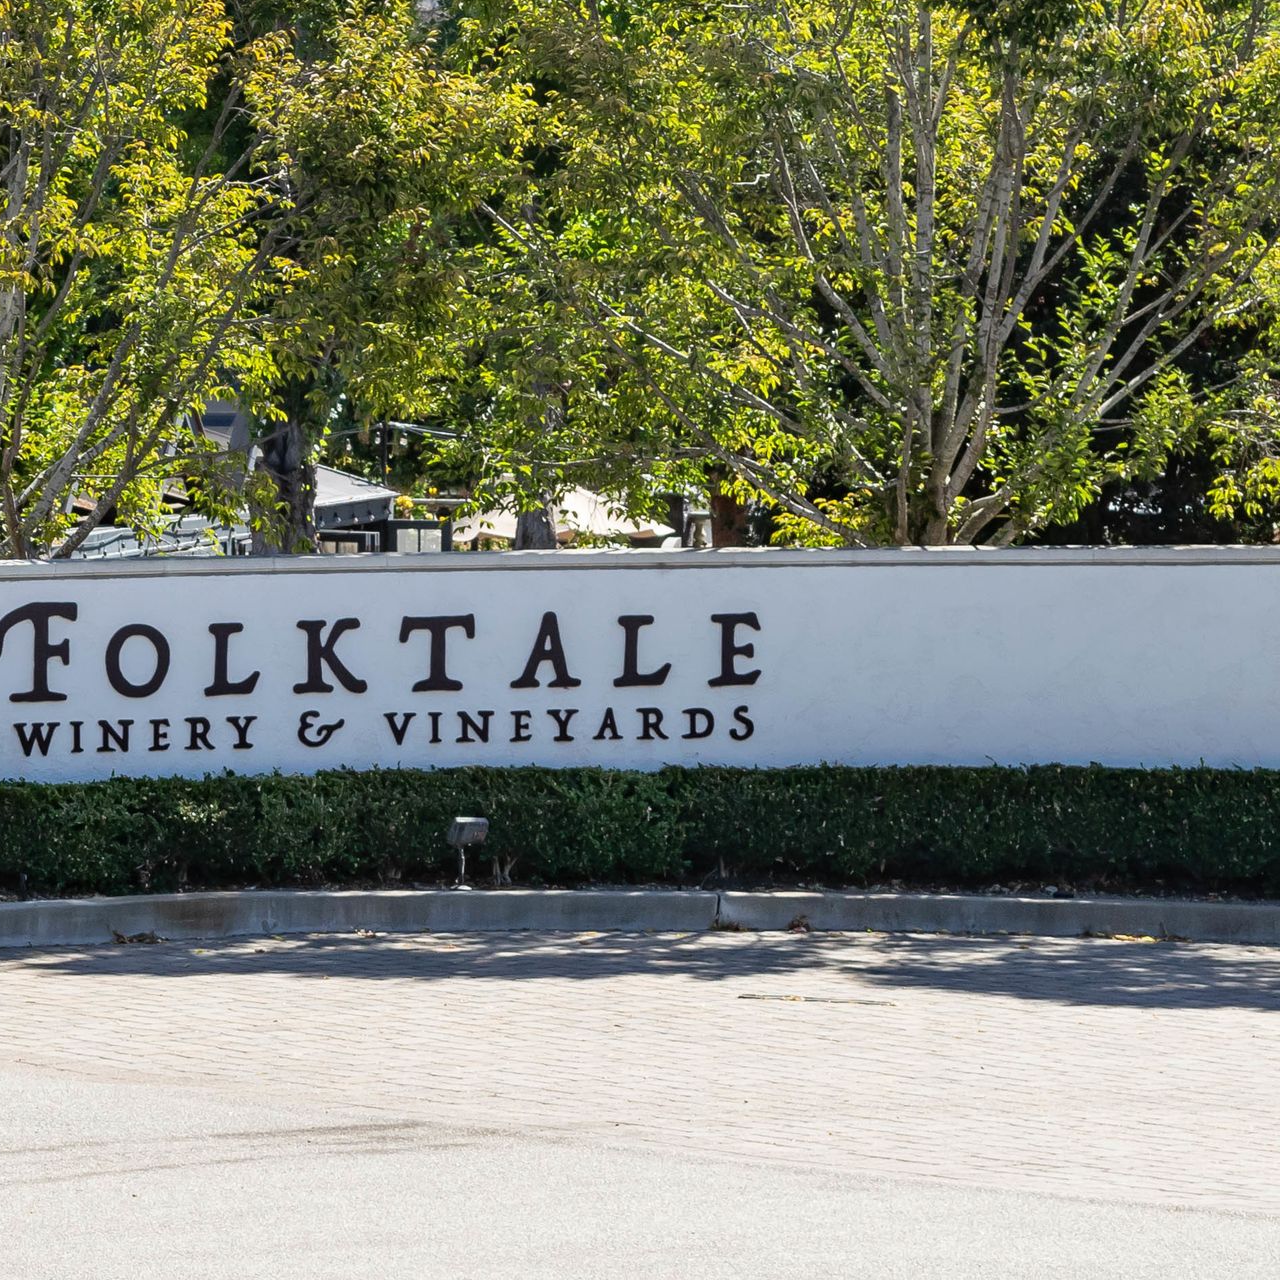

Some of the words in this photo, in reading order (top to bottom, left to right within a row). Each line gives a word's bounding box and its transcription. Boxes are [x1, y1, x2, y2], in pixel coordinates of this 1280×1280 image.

[12, 715, 259, 758] WINERY
[297, 710, 345, 748] &
[383, 704, 756, 746] VINEYARDS
